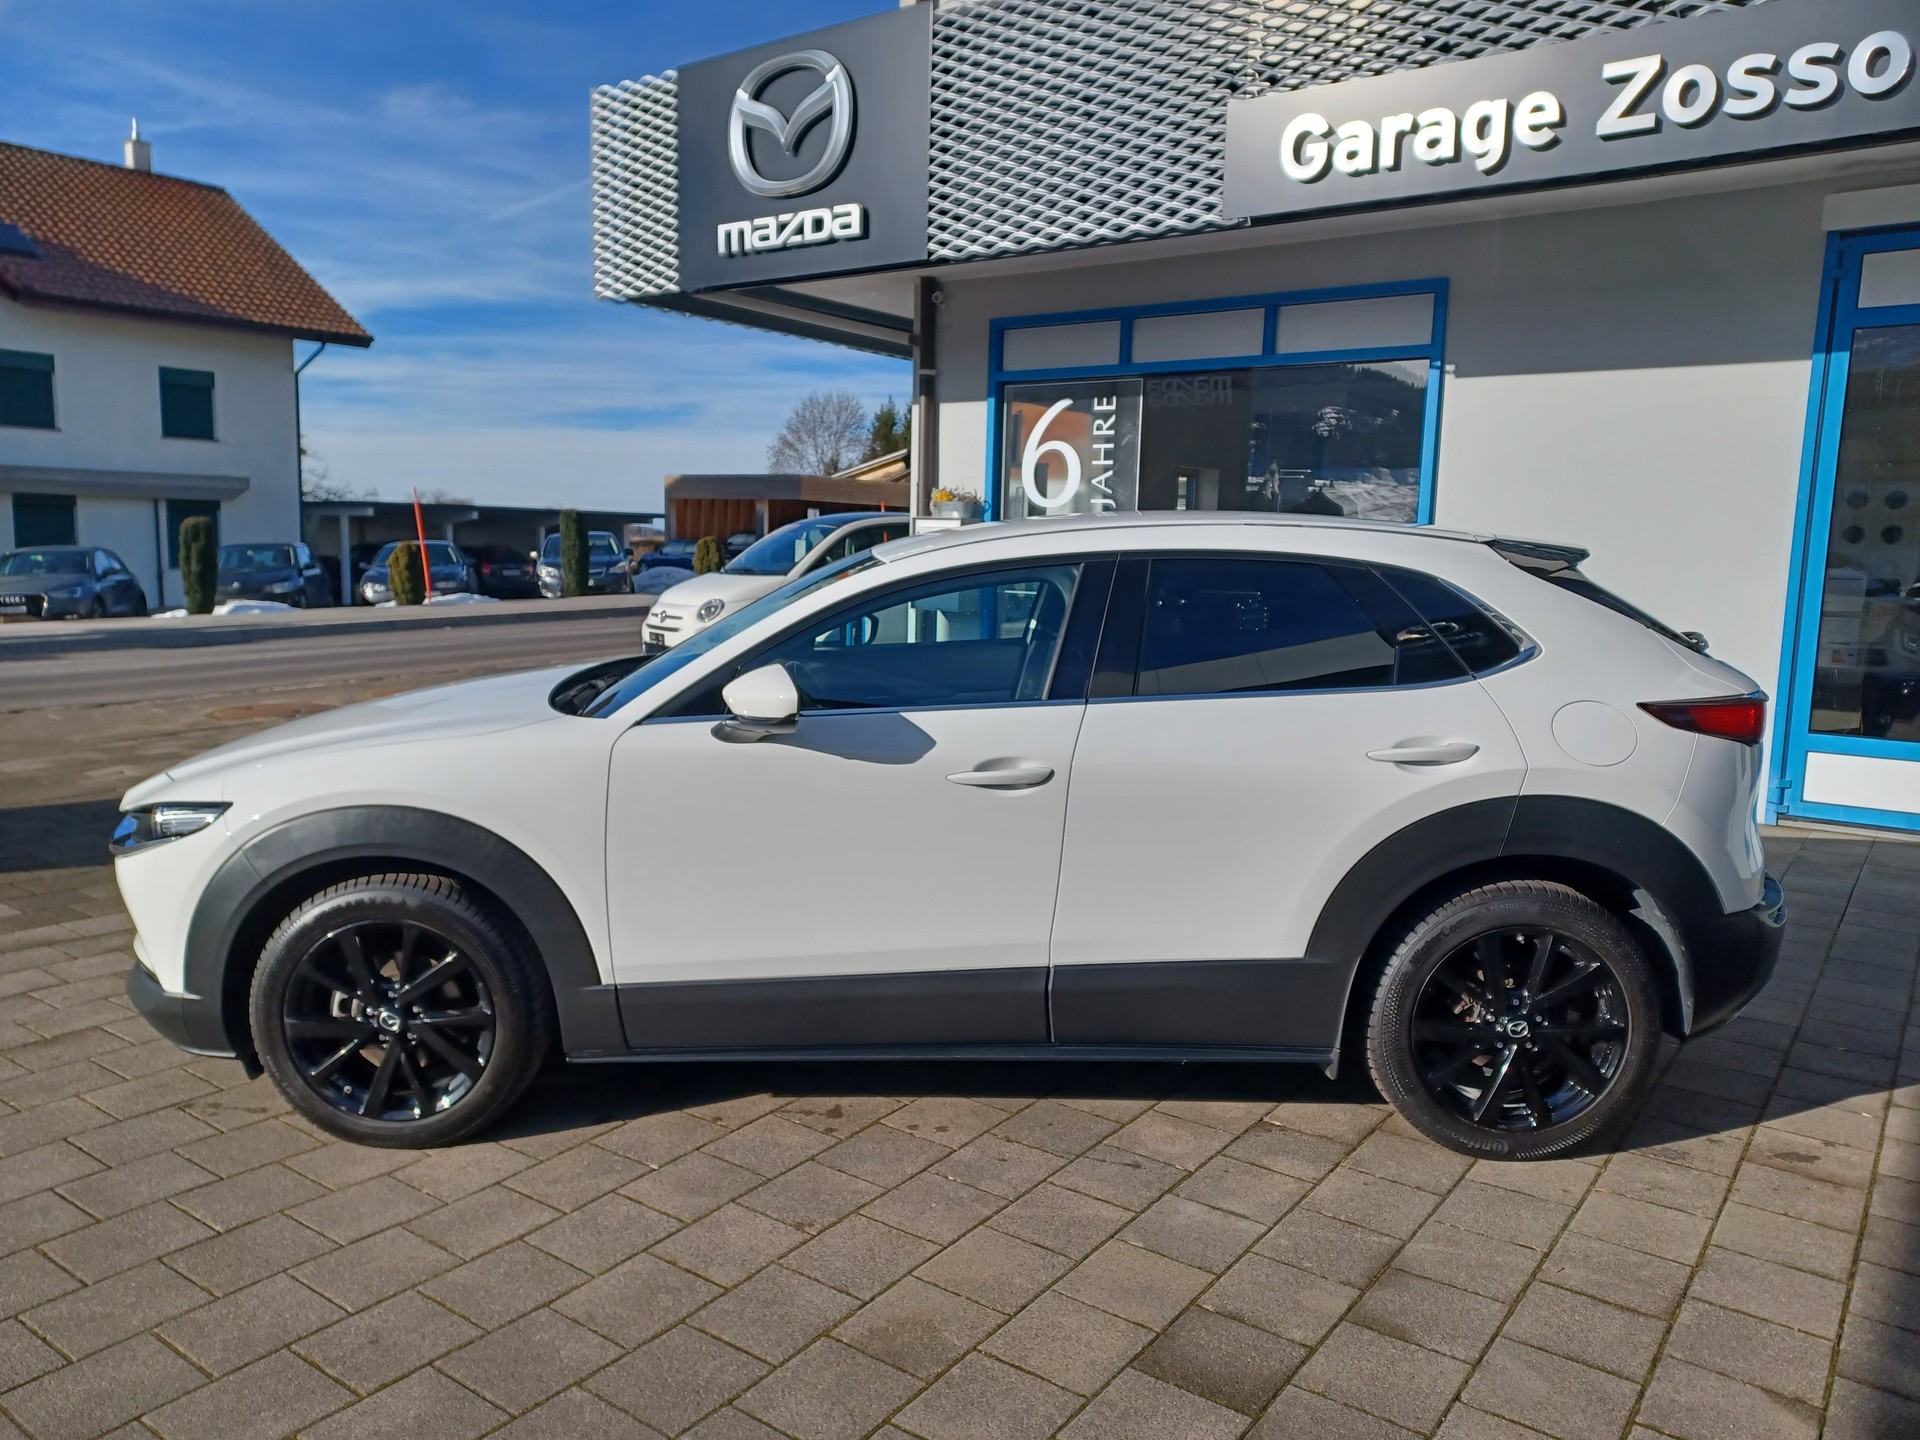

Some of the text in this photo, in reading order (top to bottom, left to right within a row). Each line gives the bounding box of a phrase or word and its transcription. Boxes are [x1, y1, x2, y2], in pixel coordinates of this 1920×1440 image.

[1280, 30, 1911, 182] Garage Zosso
[717, 202, 865, 256] mazda
[1022, 395, 1117, 509] 6 JAHRE
